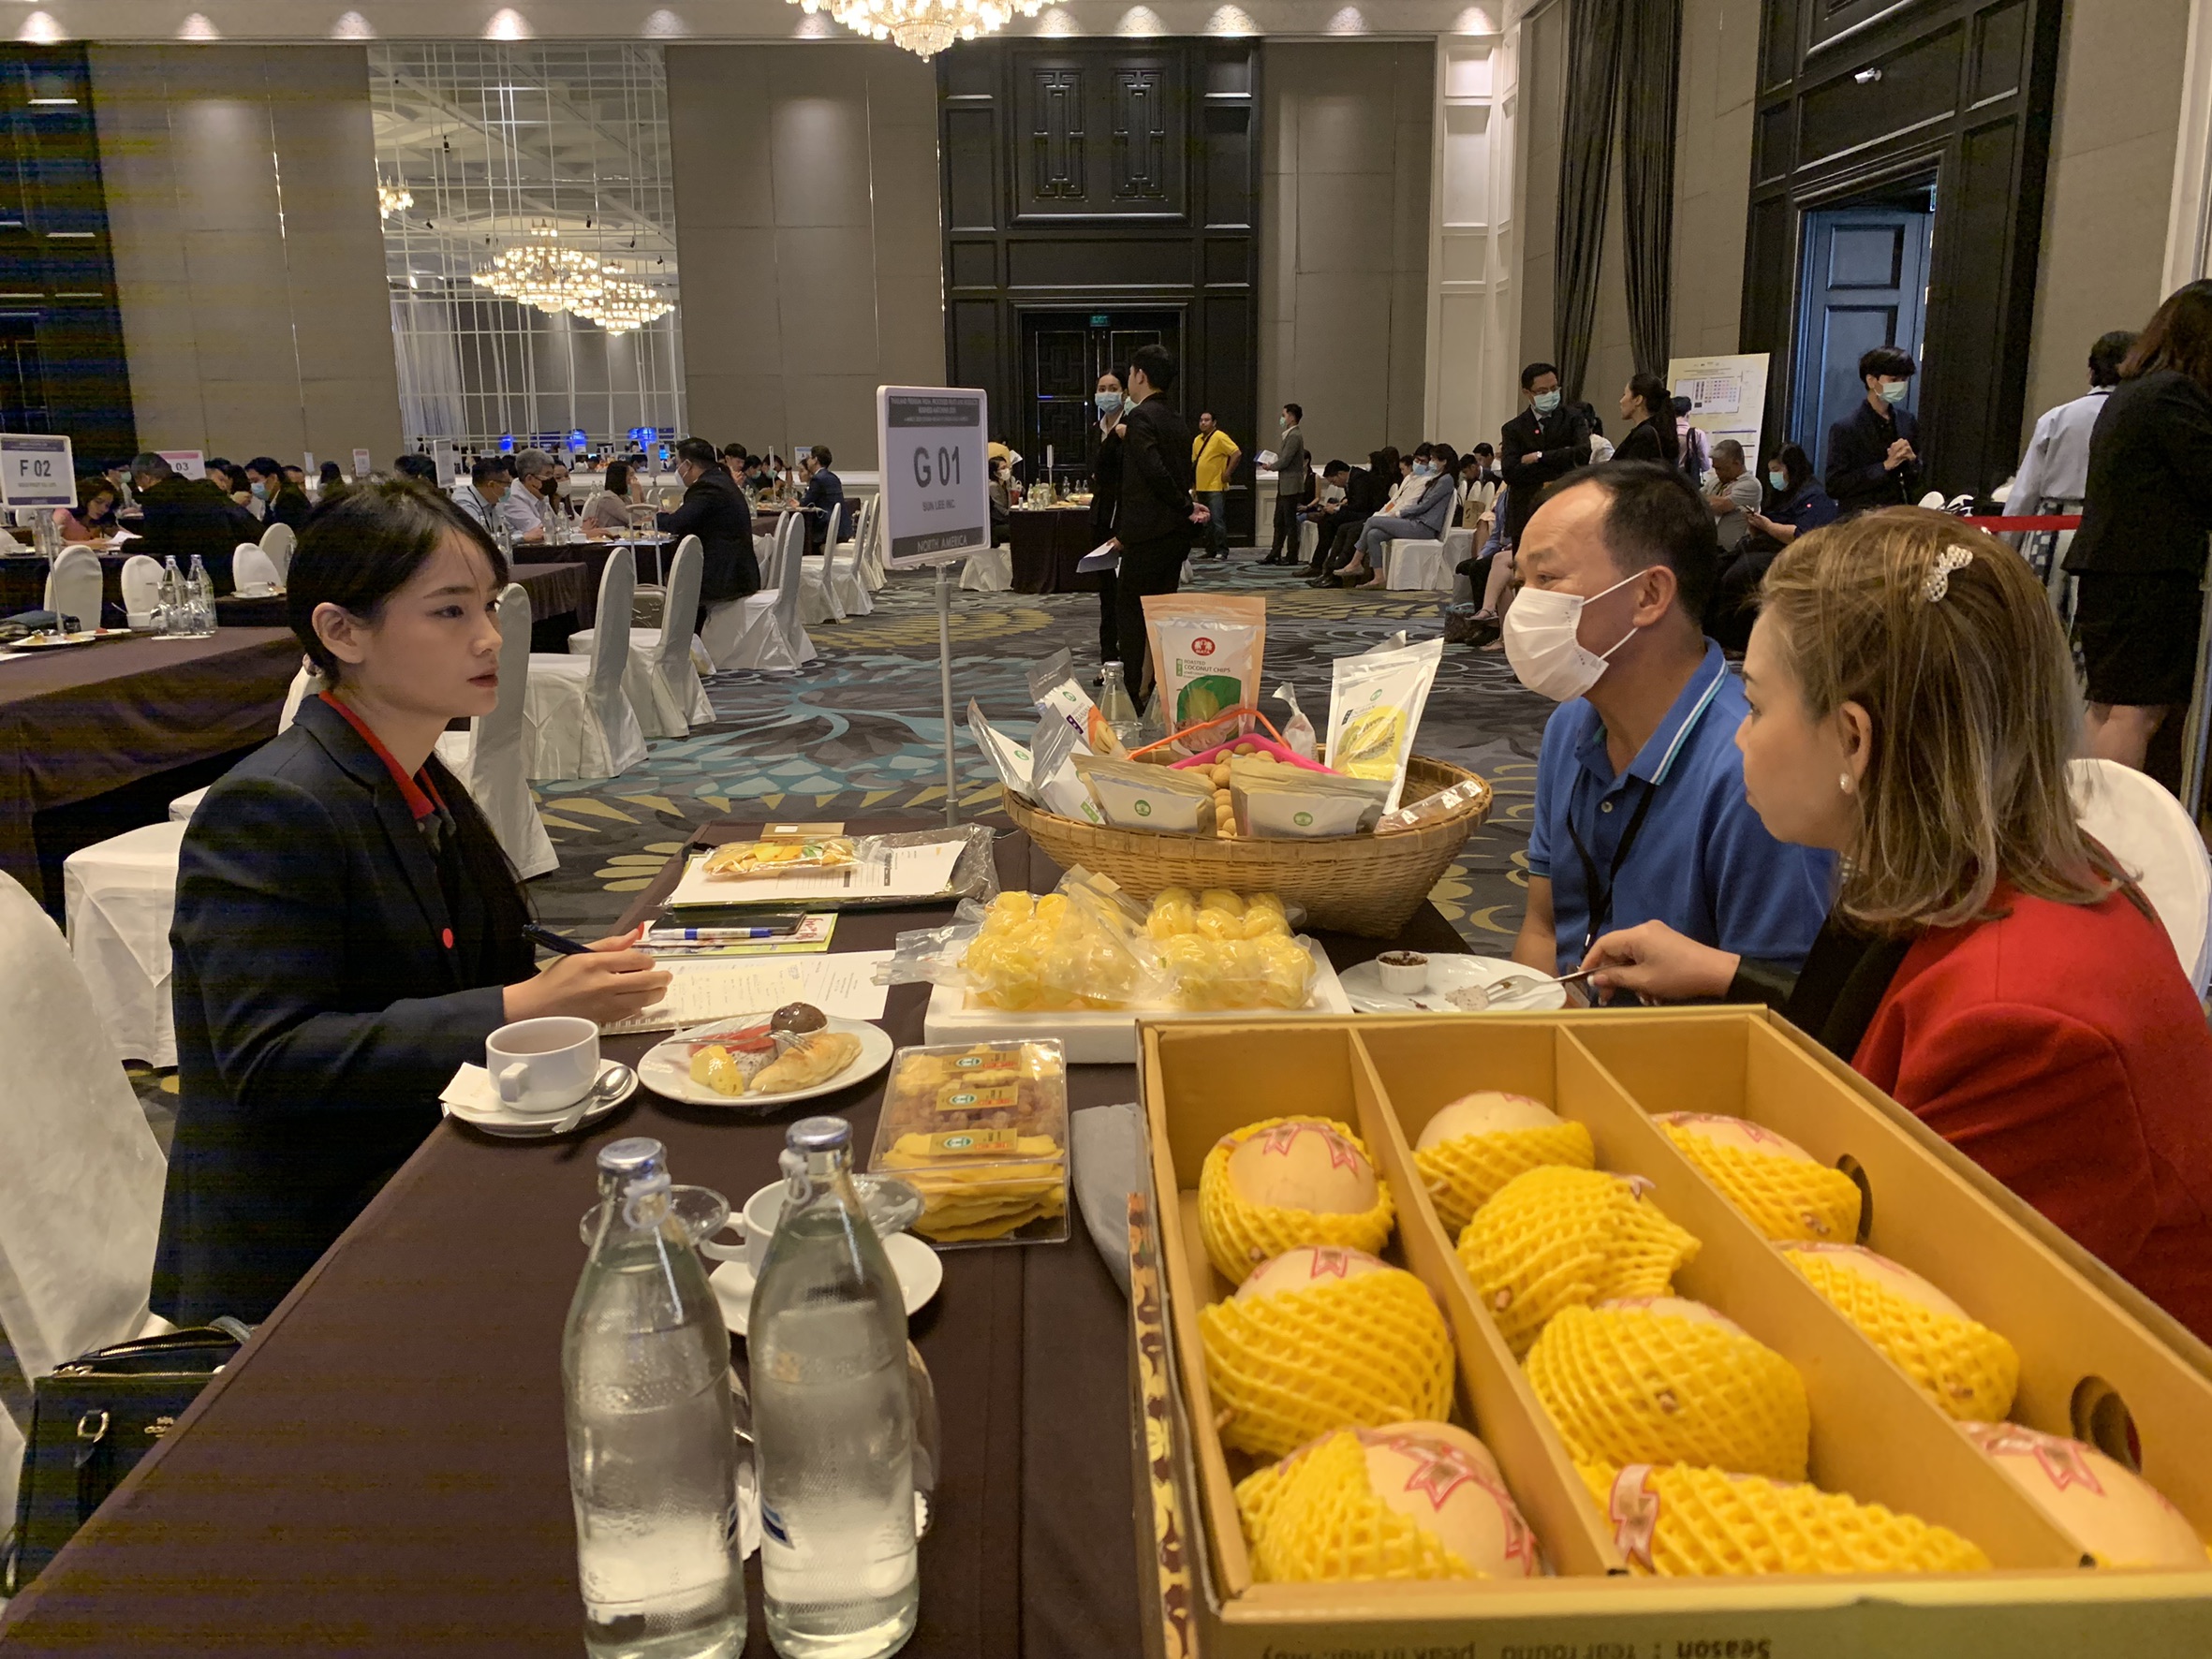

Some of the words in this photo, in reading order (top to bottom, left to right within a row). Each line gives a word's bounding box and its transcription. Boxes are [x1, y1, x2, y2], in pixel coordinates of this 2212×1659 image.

[1092, 316, 1108, 324] EXIT
[20, 459, 28, 477] F
[35, 459, 52, 477] 02
[175, 462, 189, 471] 03
[913, 446, 932, 488] G
[938, 446, 960, 486] 01
[935, 499, 945, 510] LEE
[918, 537, 939, 552] NORTH
[941, 535, 967, 549] AMERICA
[1184, 664, 1212, 672] COCONUT
